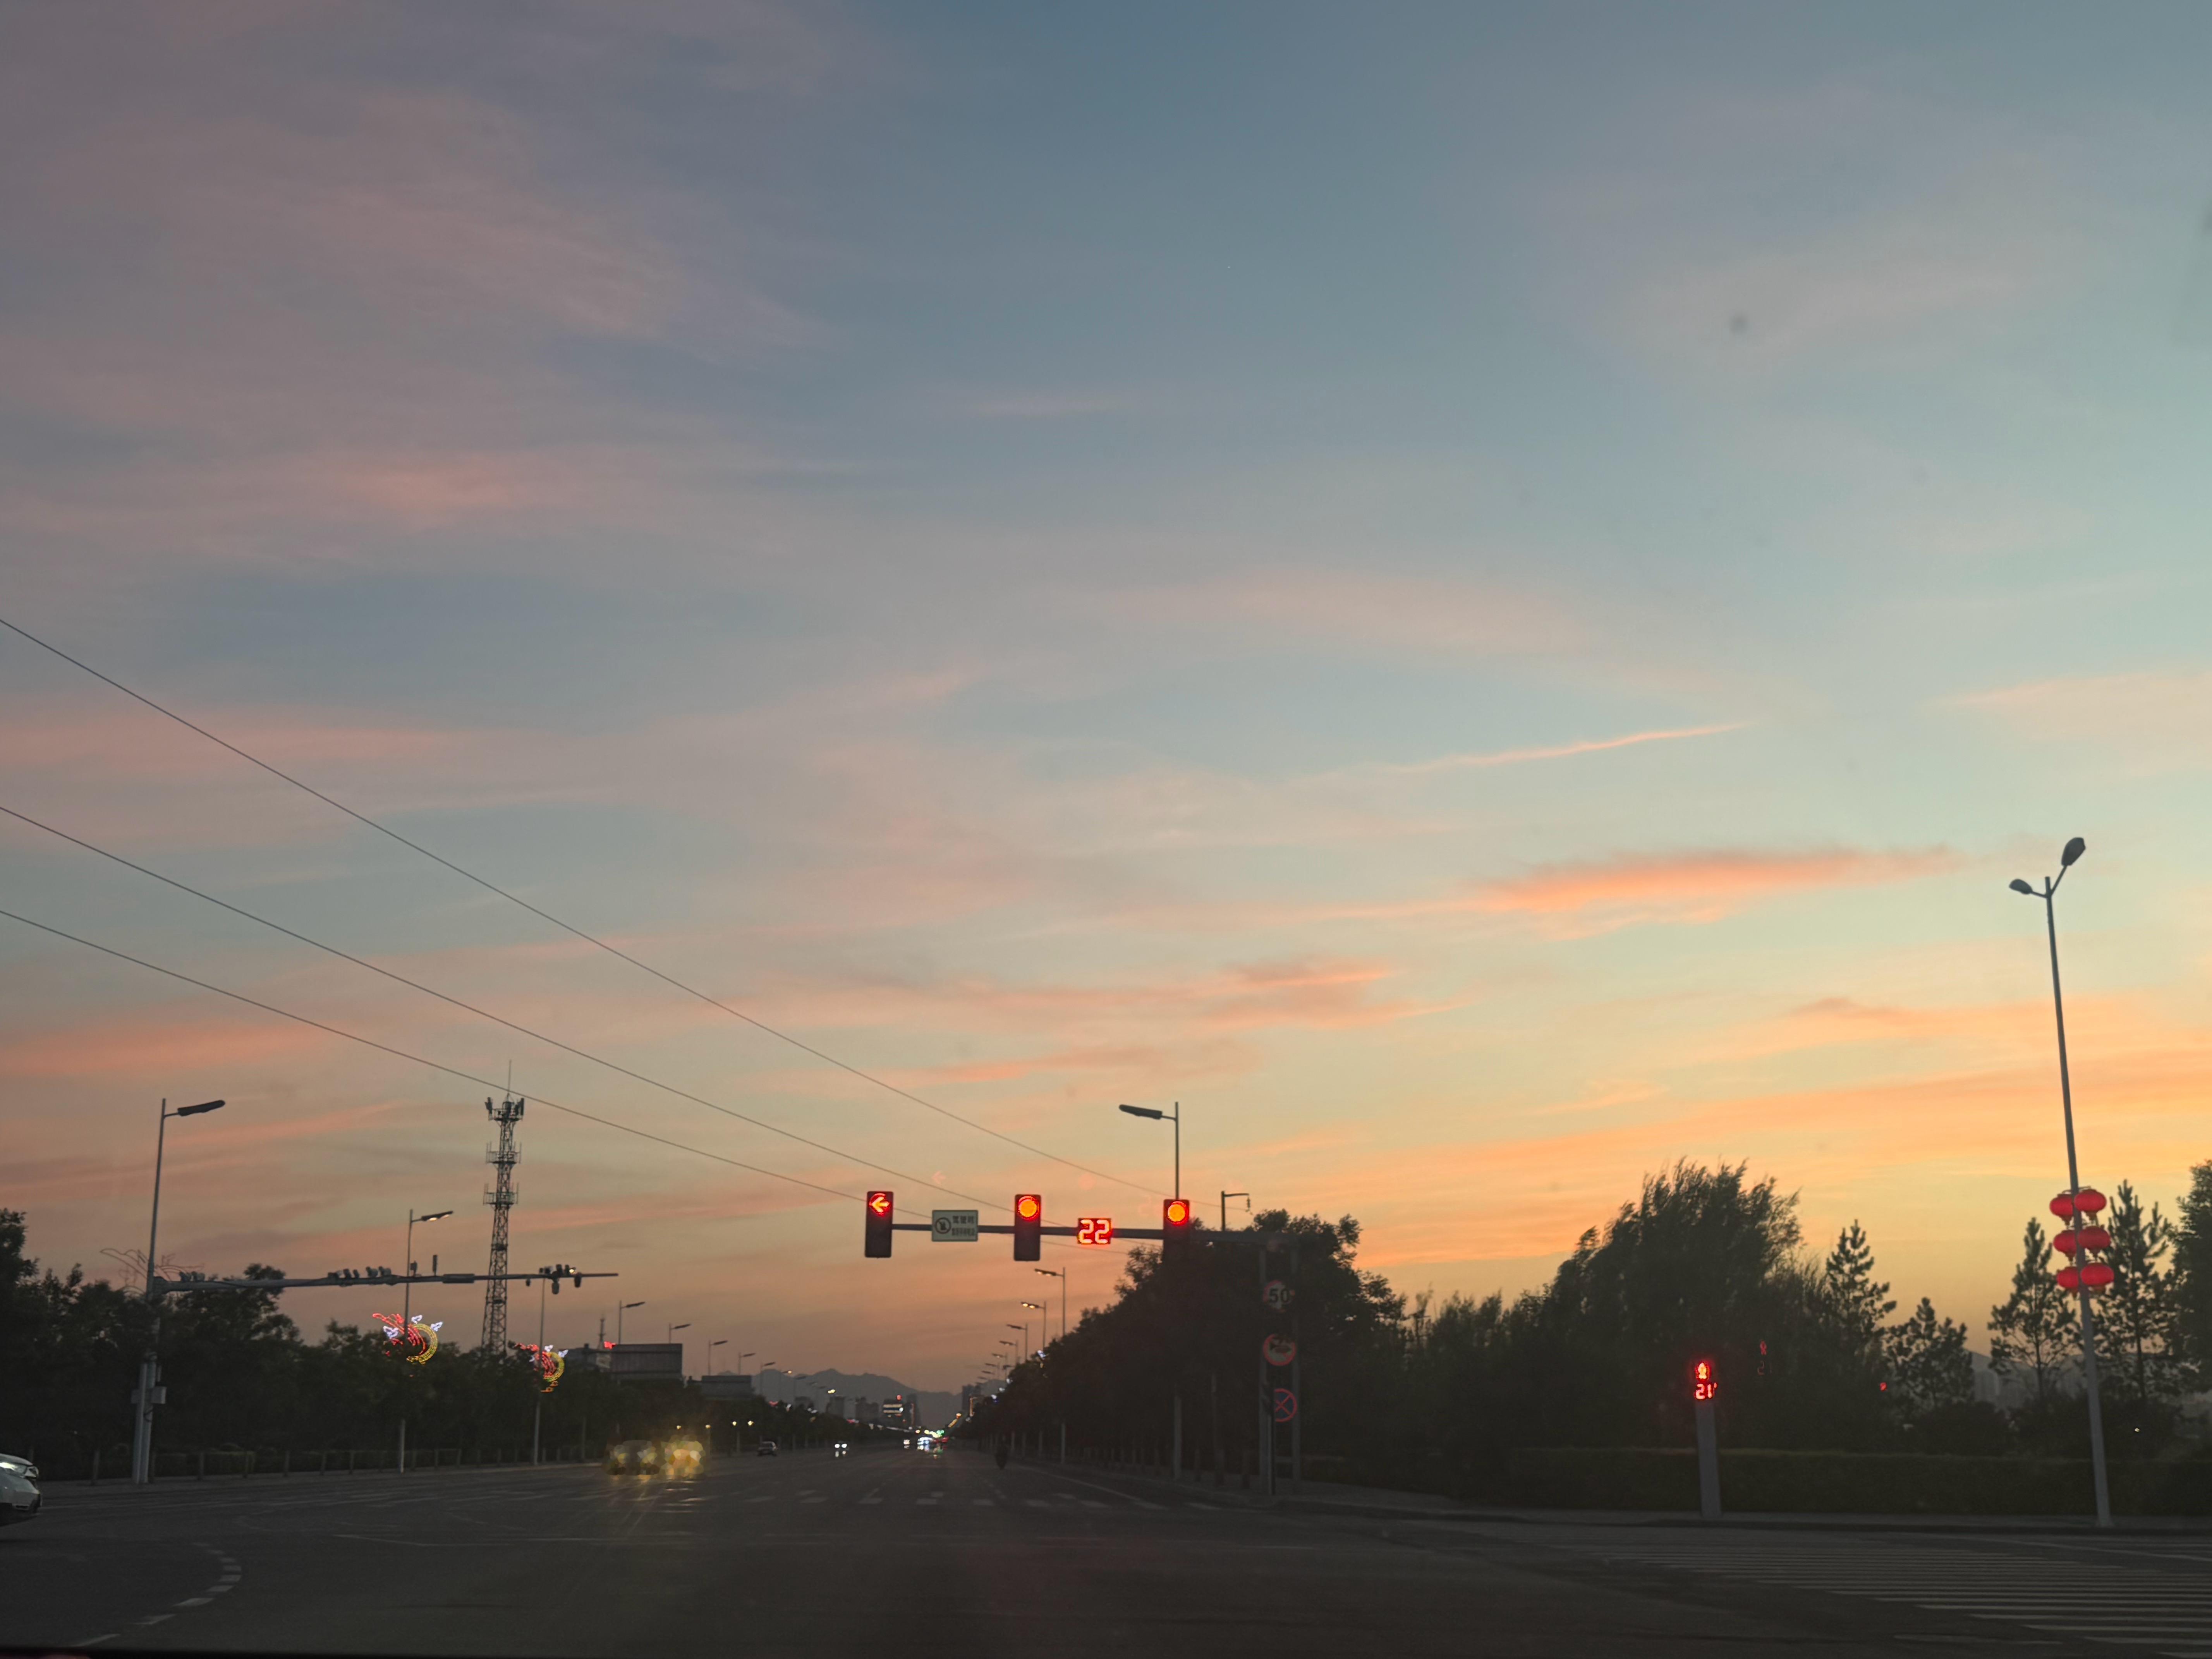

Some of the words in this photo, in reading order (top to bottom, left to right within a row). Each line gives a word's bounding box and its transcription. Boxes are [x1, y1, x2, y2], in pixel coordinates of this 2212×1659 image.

[1079, 1219, 1109, 1244] 22
[1270, 1288, 1289, 1302] 50
[1695, 1383, 1712, 1399] 21
